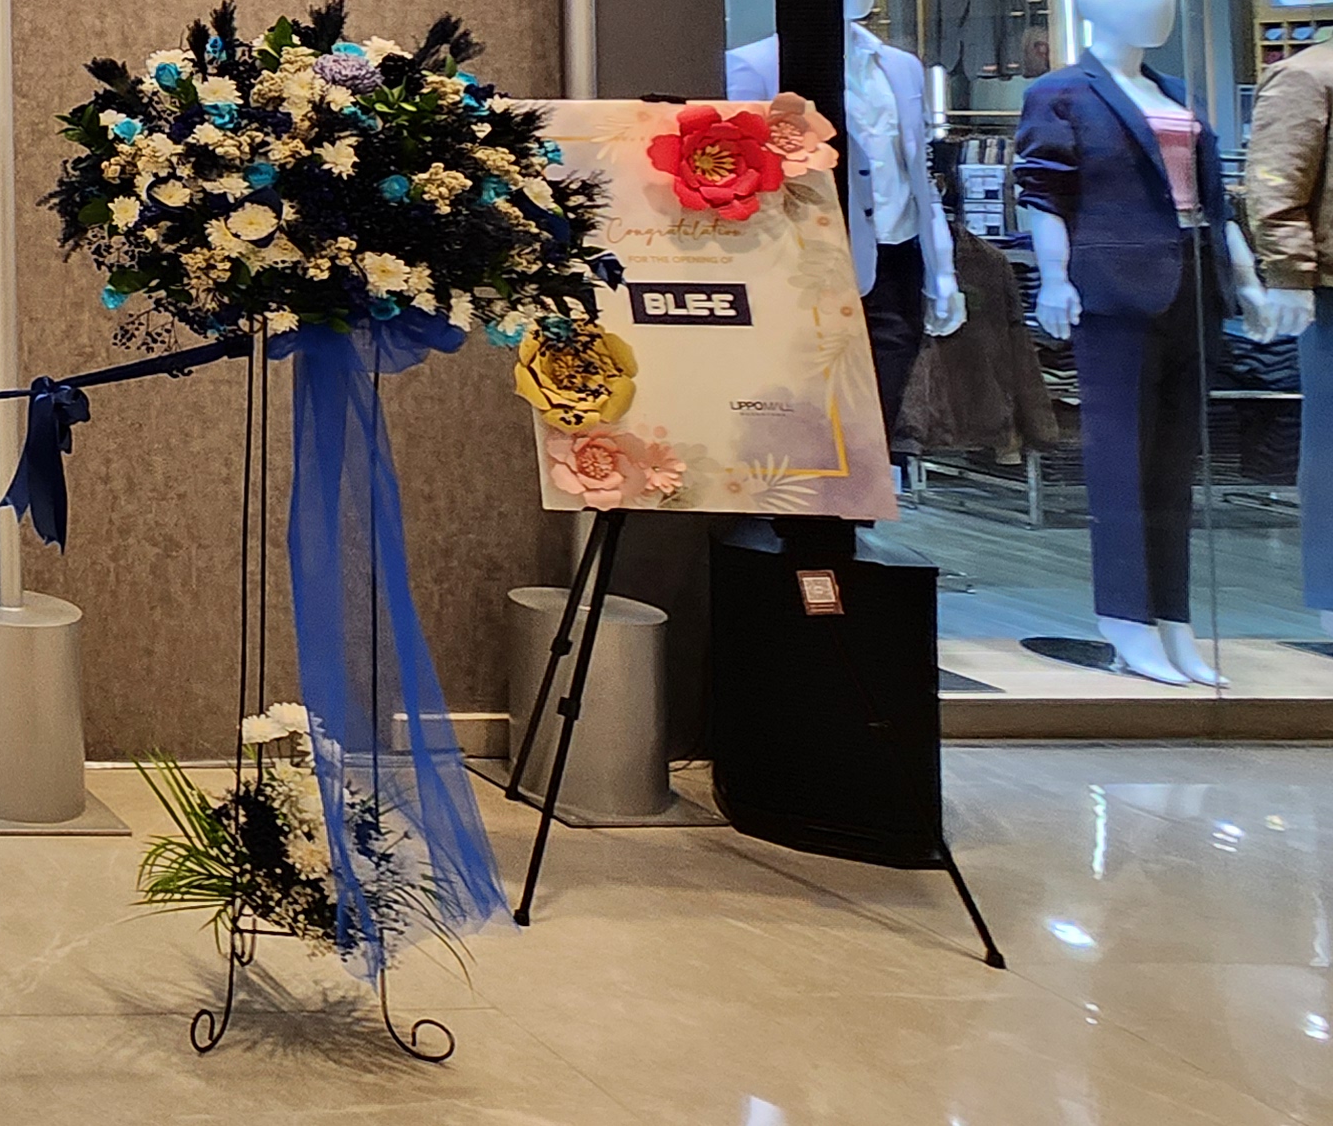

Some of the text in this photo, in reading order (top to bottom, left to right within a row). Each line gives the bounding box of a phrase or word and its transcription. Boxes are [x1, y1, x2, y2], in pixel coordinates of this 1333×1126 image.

[628, 255, 733, 264] FOR THE OPENING OF
[643, 292, 737, 316] BLEE
